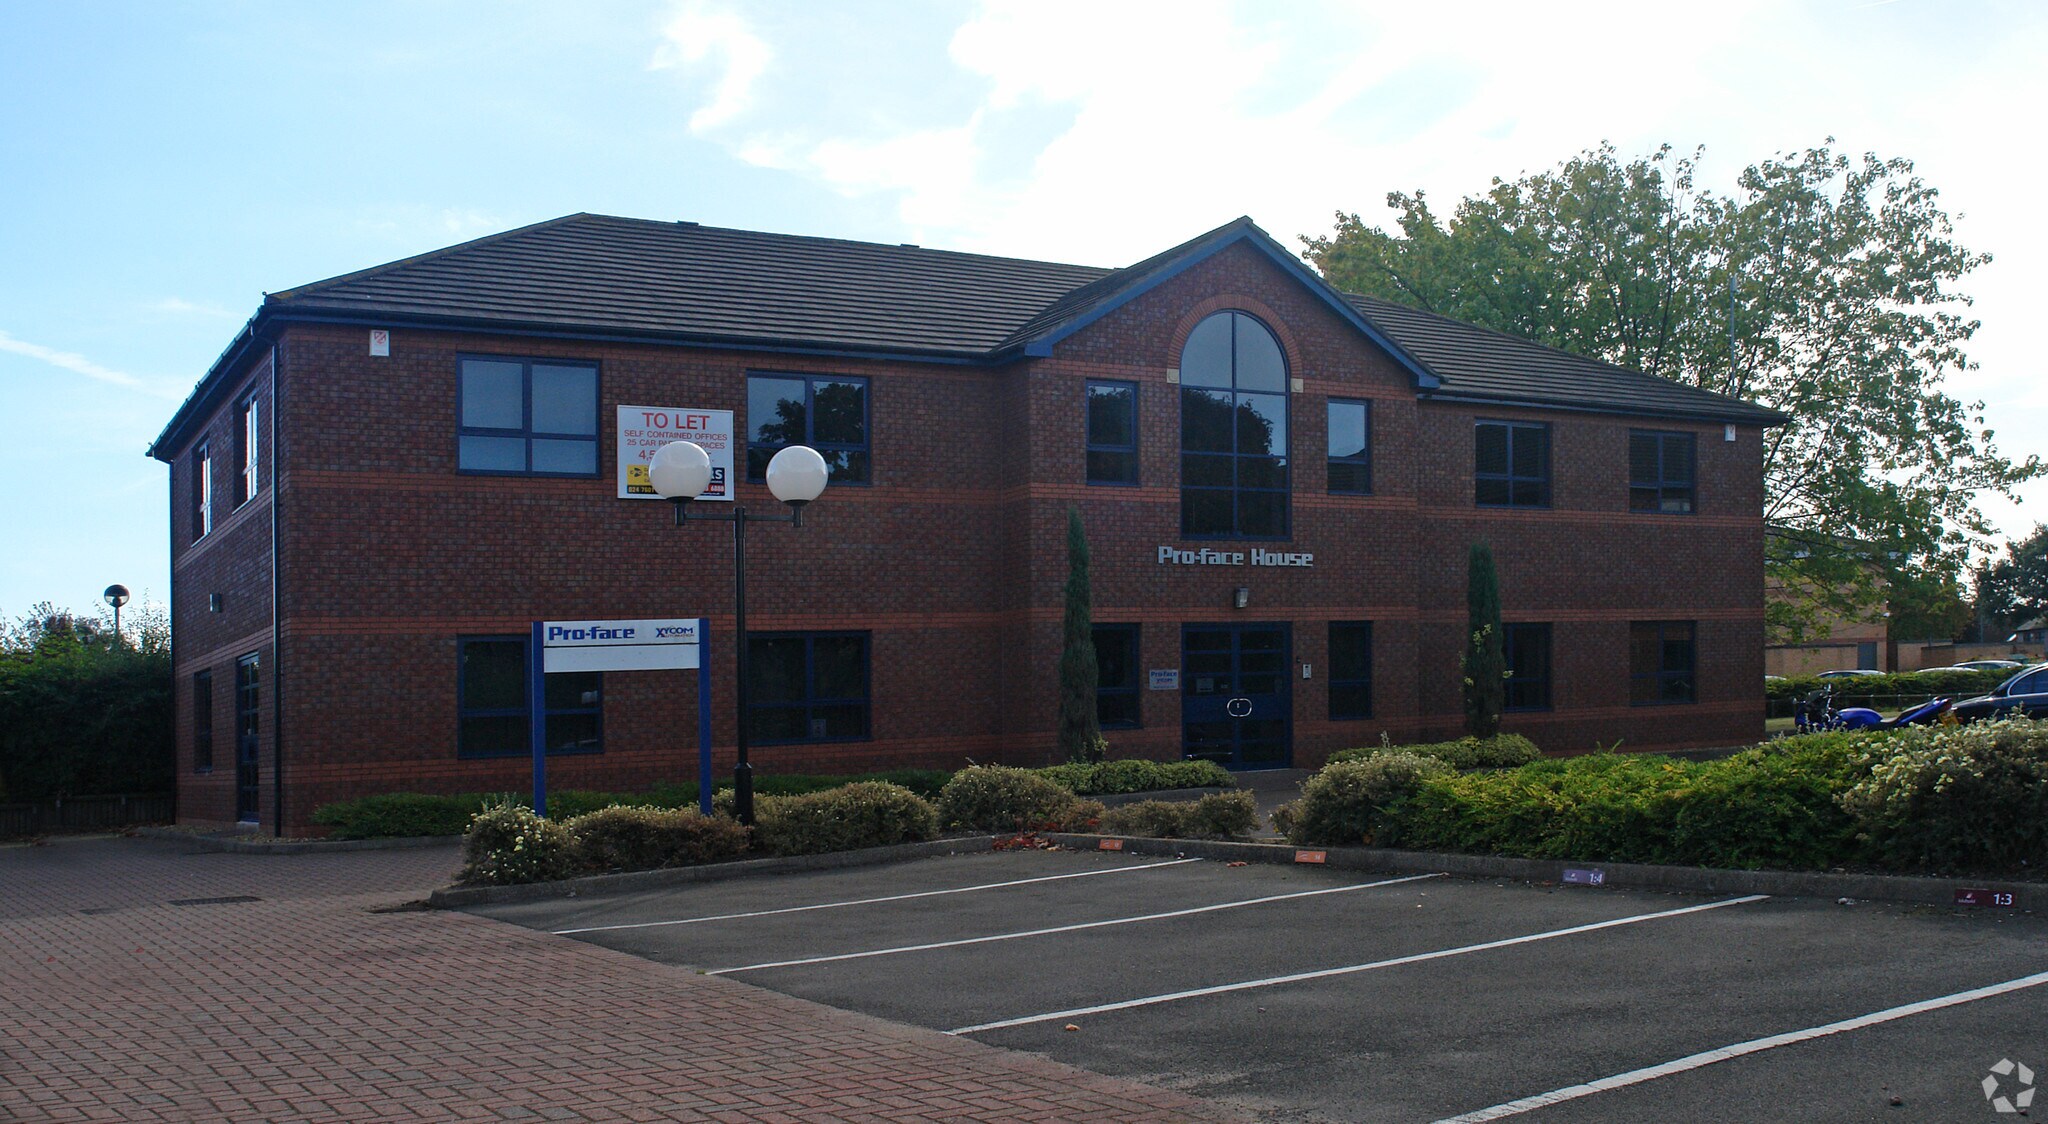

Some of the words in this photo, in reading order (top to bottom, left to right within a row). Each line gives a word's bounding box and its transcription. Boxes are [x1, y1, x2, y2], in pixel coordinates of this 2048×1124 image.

[642, 412, 668, 429] TO
[675, 414, 710, 430] LET
[624, 429, 644, 437] SELF
[647, 430, 692, 440] CONTAINED
[694, 432, 728, 441] OFFICES
[639, 439, 656, 447] CAR
[1158, 545, 1244, 565] Pro-face
[1251, 548, 1313, 567] House
[549, 626, 635, 640] Pro-face
[655, 627, 694, 638] XYCOM
[1993, 893, 2012, 905] 1:3
